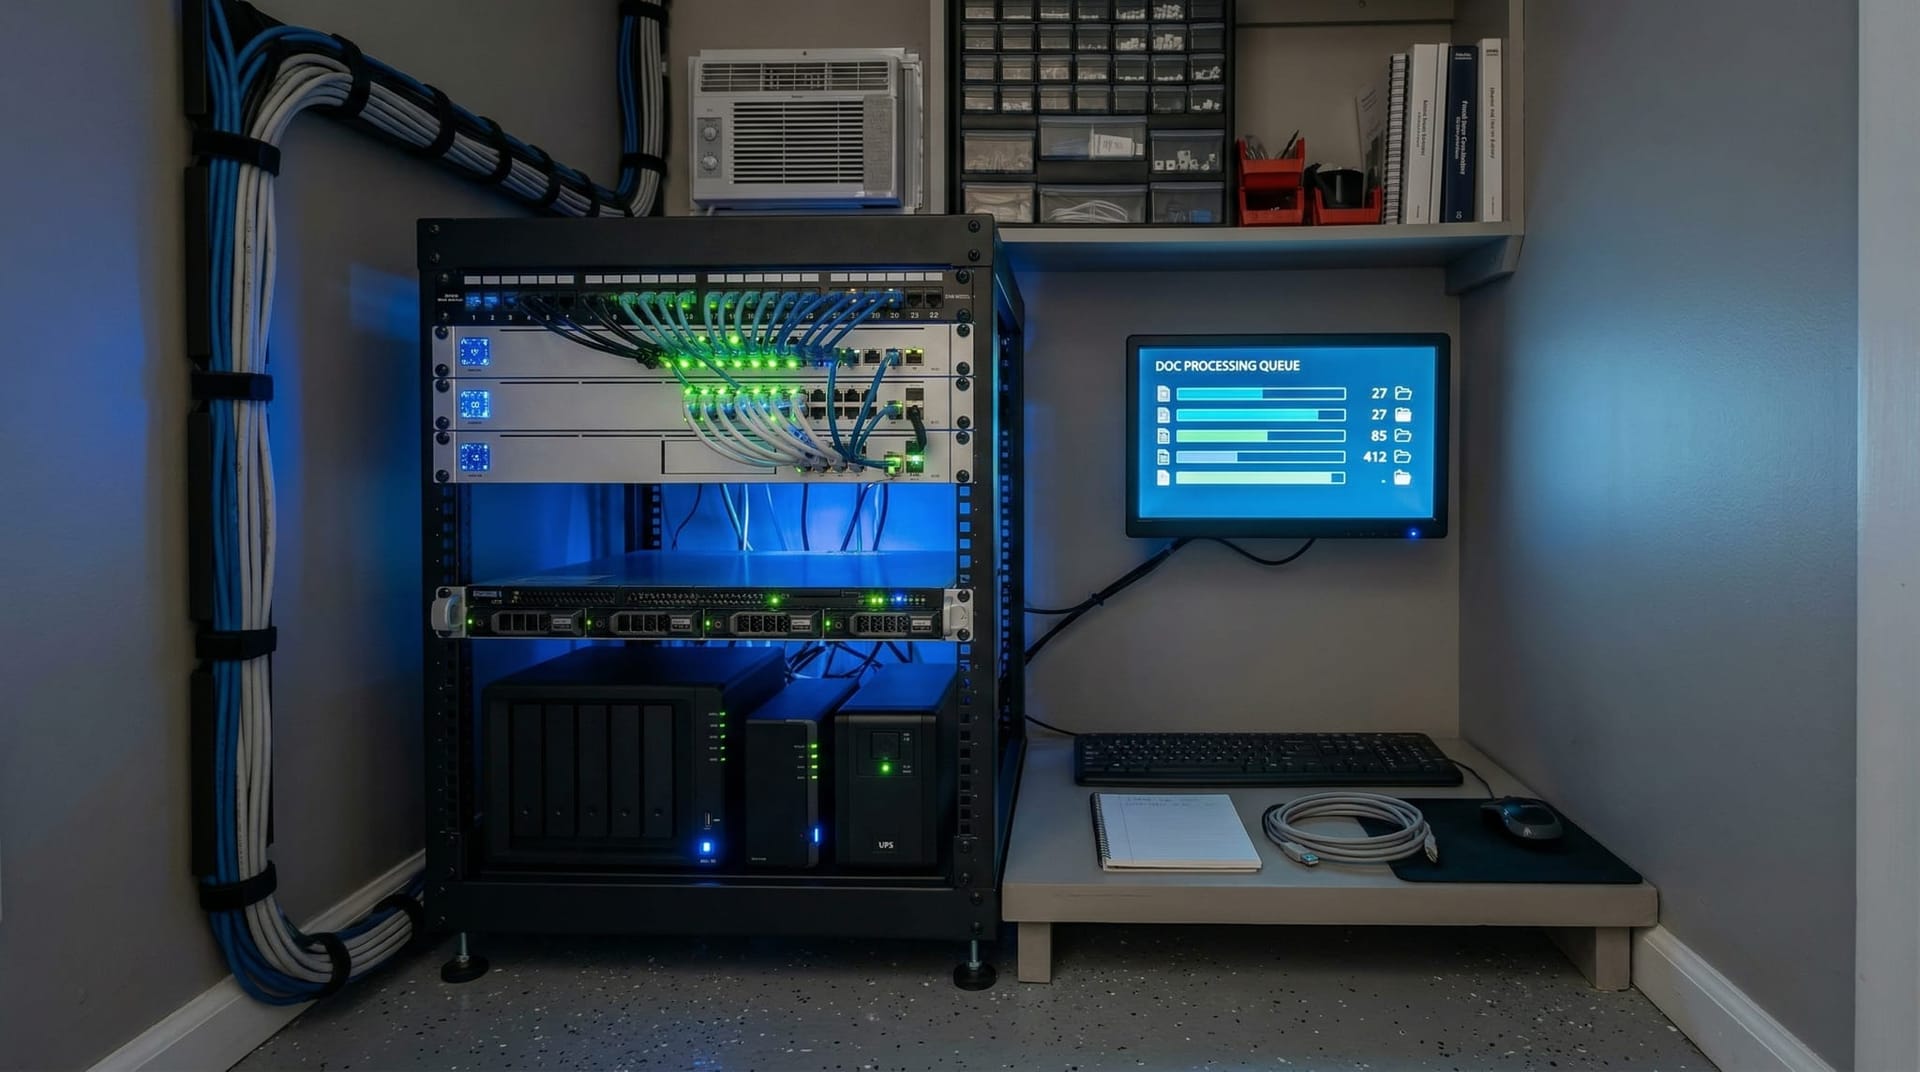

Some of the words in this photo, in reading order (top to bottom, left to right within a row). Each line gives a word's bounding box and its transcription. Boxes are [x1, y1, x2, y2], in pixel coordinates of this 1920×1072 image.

[1155, 360, 1182, 372] DOC
[1183, 360, 1257, 372] PROCESSING
[1259, 360, 1301, 373] QUEUE
[1371, 387, 1388, 399] 27
[1371, 408, 1388, 421] 27
[1370, 429, 1388, 442] 85
[1363, 451, 1388, 463] 412
[878, 841, 894, 849] UPS
